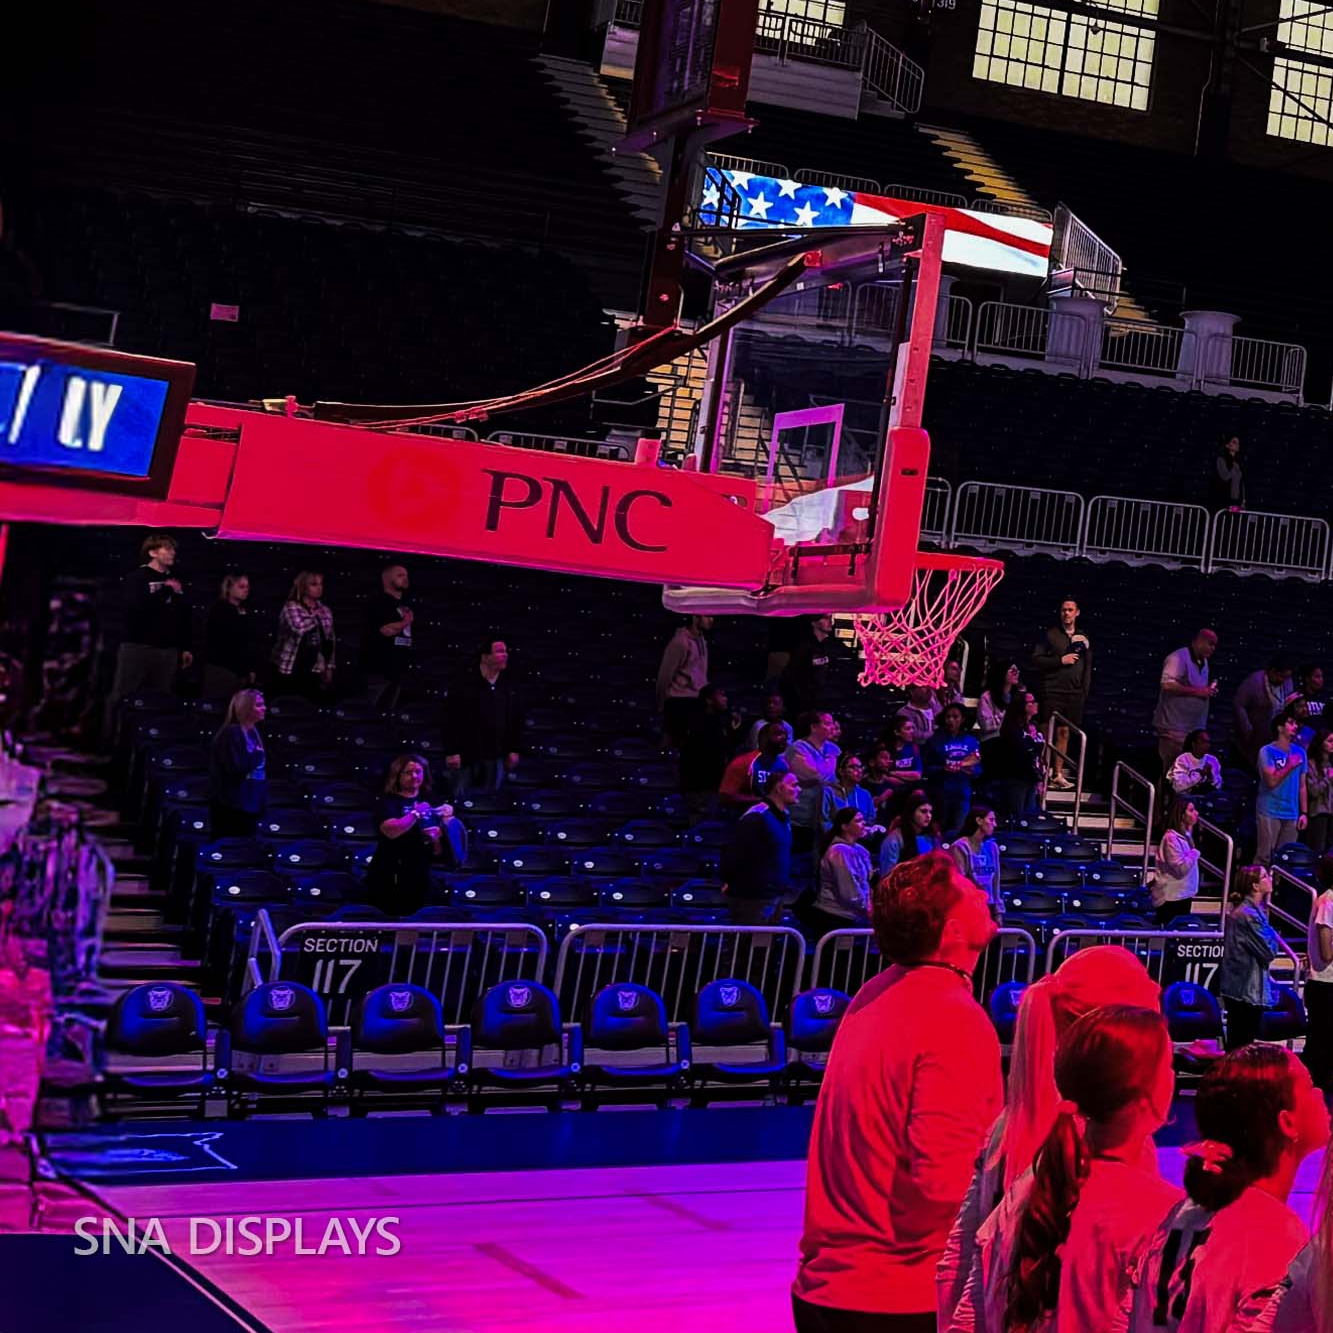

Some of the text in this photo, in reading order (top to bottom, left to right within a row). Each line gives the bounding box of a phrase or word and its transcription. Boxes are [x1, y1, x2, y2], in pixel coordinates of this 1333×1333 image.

[481, 469, 673, 552] PNC
[303, 937, 379, 953] SECTION
[312, 958, 363, 994] 117
